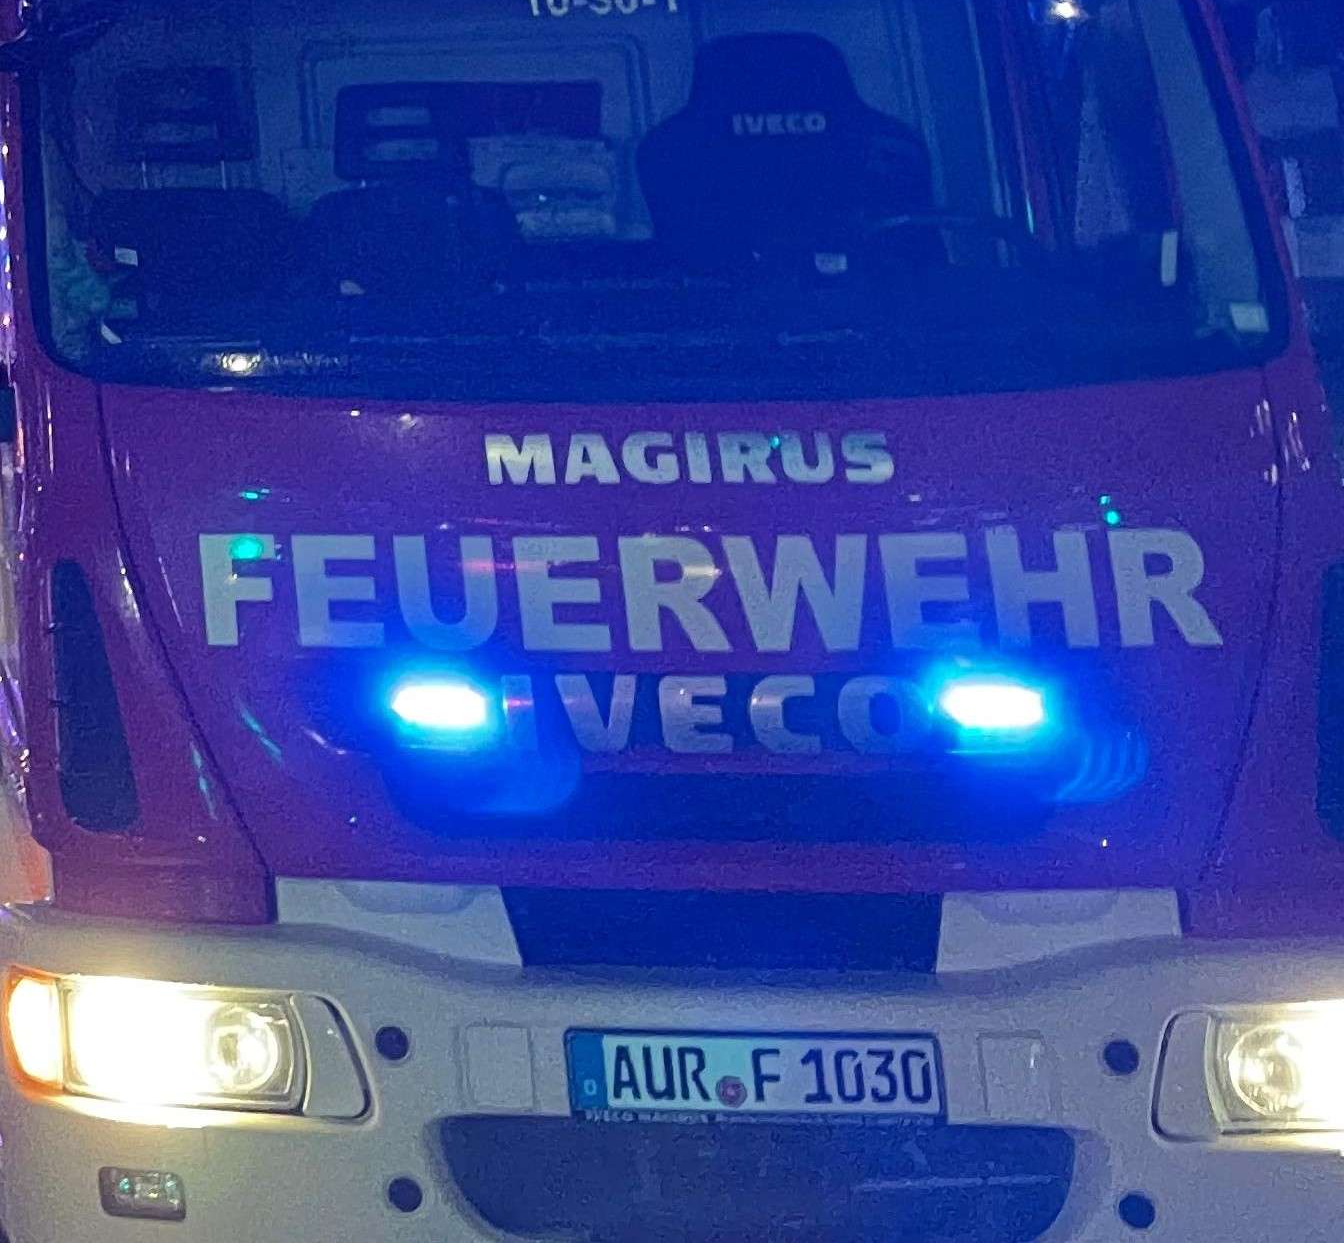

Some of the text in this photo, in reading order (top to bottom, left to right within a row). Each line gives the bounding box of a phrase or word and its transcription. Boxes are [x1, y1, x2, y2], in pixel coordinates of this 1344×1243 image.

[732, 112, 827, 136] IVECO
[484, 429, 896, 486] MAGIRUS
[198, 525, 1223, 653] FEUERWEHR
[612, 1044, 711, 1102] AUR
[751, 1047, 781, 1103] F
[800, 1047, 933, 1104] 1030
